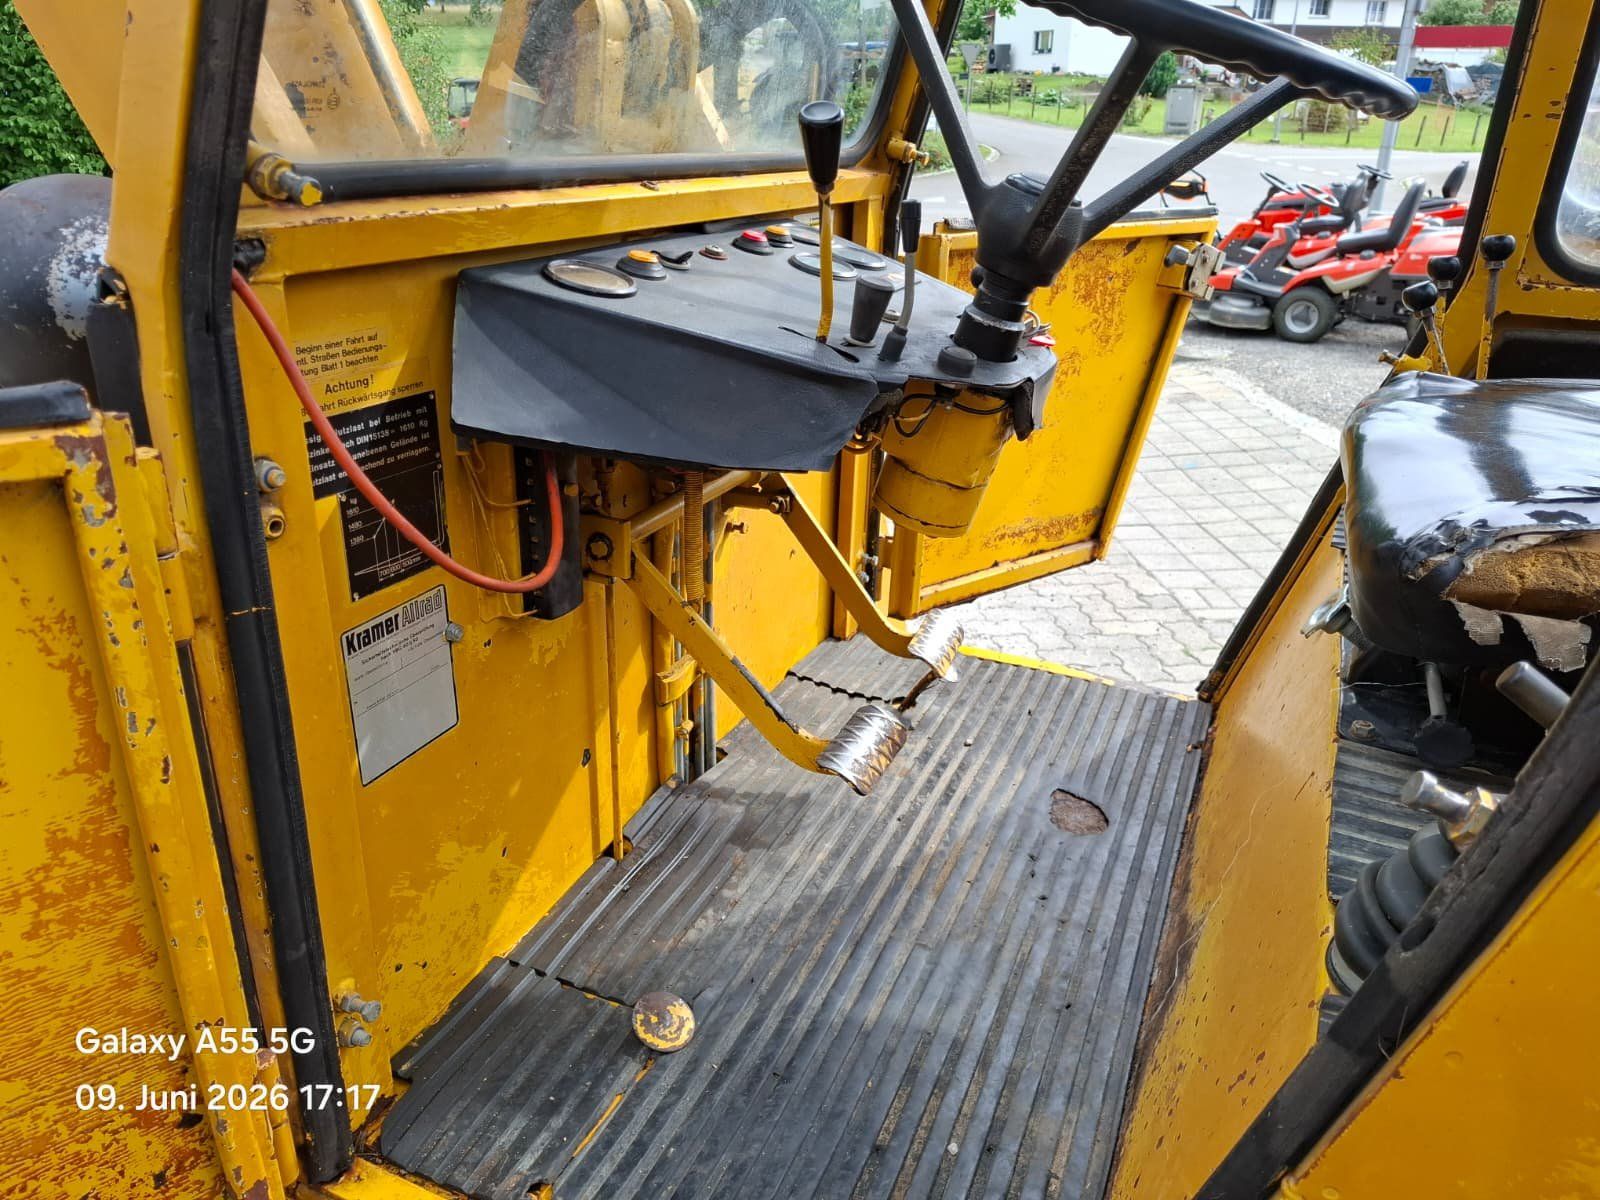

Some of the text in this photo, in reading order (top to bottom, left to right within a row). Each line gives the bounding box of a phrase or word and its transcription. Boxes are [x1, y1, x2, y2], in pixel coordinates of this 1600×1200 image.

[295, 333, 378, 355] Beginn einer Fahrt auf
[310, 352, 340, 364] Straßen
[342, 344, 387, 357] Bedienungs-
[321, 361, 338, 373] Blatt
[345, 354, 379, 367] beachten
[337, 389, 396, 406] Rückwärtsgang
[397, 381, 424, 395] sperren
[385, 410, 412, 423] Betrieb
[416, 406, 427, 415] mit
[390, 435, 418, 448] Gelände
[421, 431, 430, 440] ist
[345, 613, 400, 657] Kramer
[402, 589, 442, 628] Allrad
